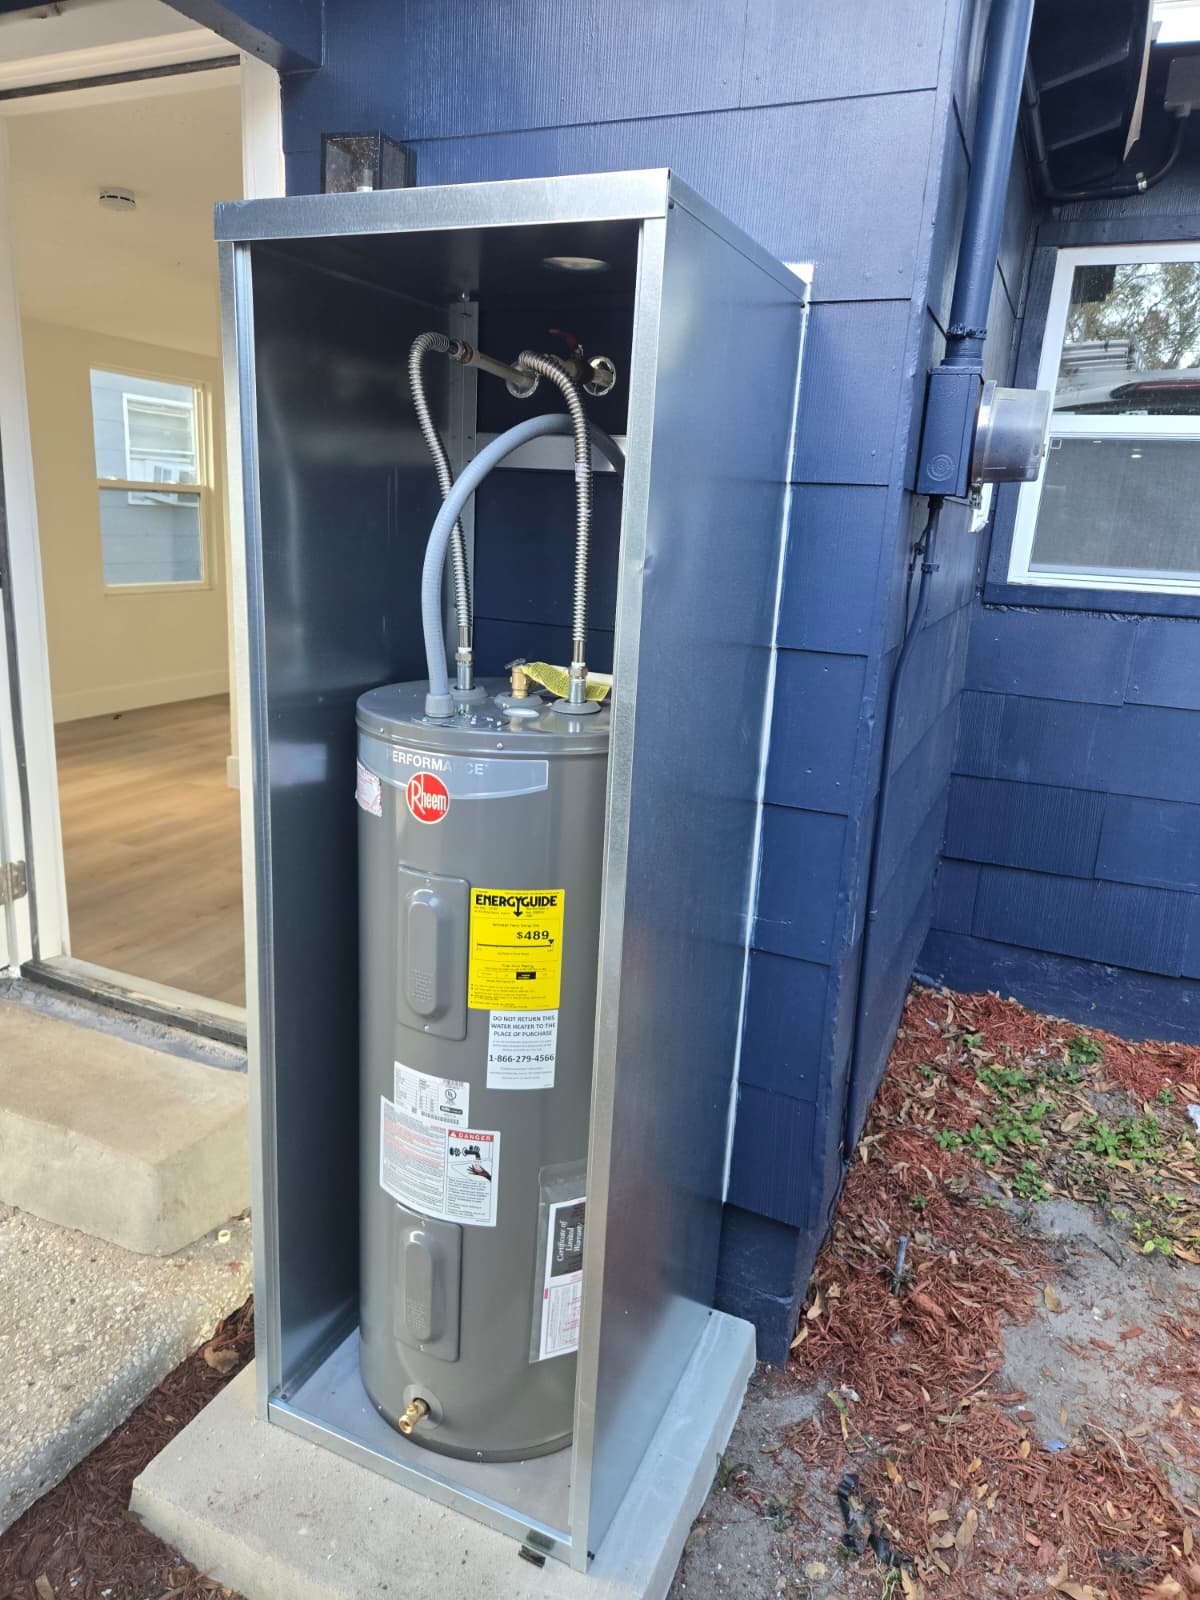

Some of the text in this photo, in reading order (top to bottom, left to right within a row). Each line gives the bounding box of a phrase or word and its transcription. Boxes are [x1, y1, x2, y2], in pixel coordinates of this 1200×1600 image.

[387, 750, 484, 775] ERFORMACE
[411, 773, 447, 814] Rheem
[475, 894, 557, 908] ENERGYGUIDE
[516, 930, 550, 940] $489
[489, 1054, 555, 1063] 1-866-279-4566
[458, 1131, 491, 1141] DANGER
